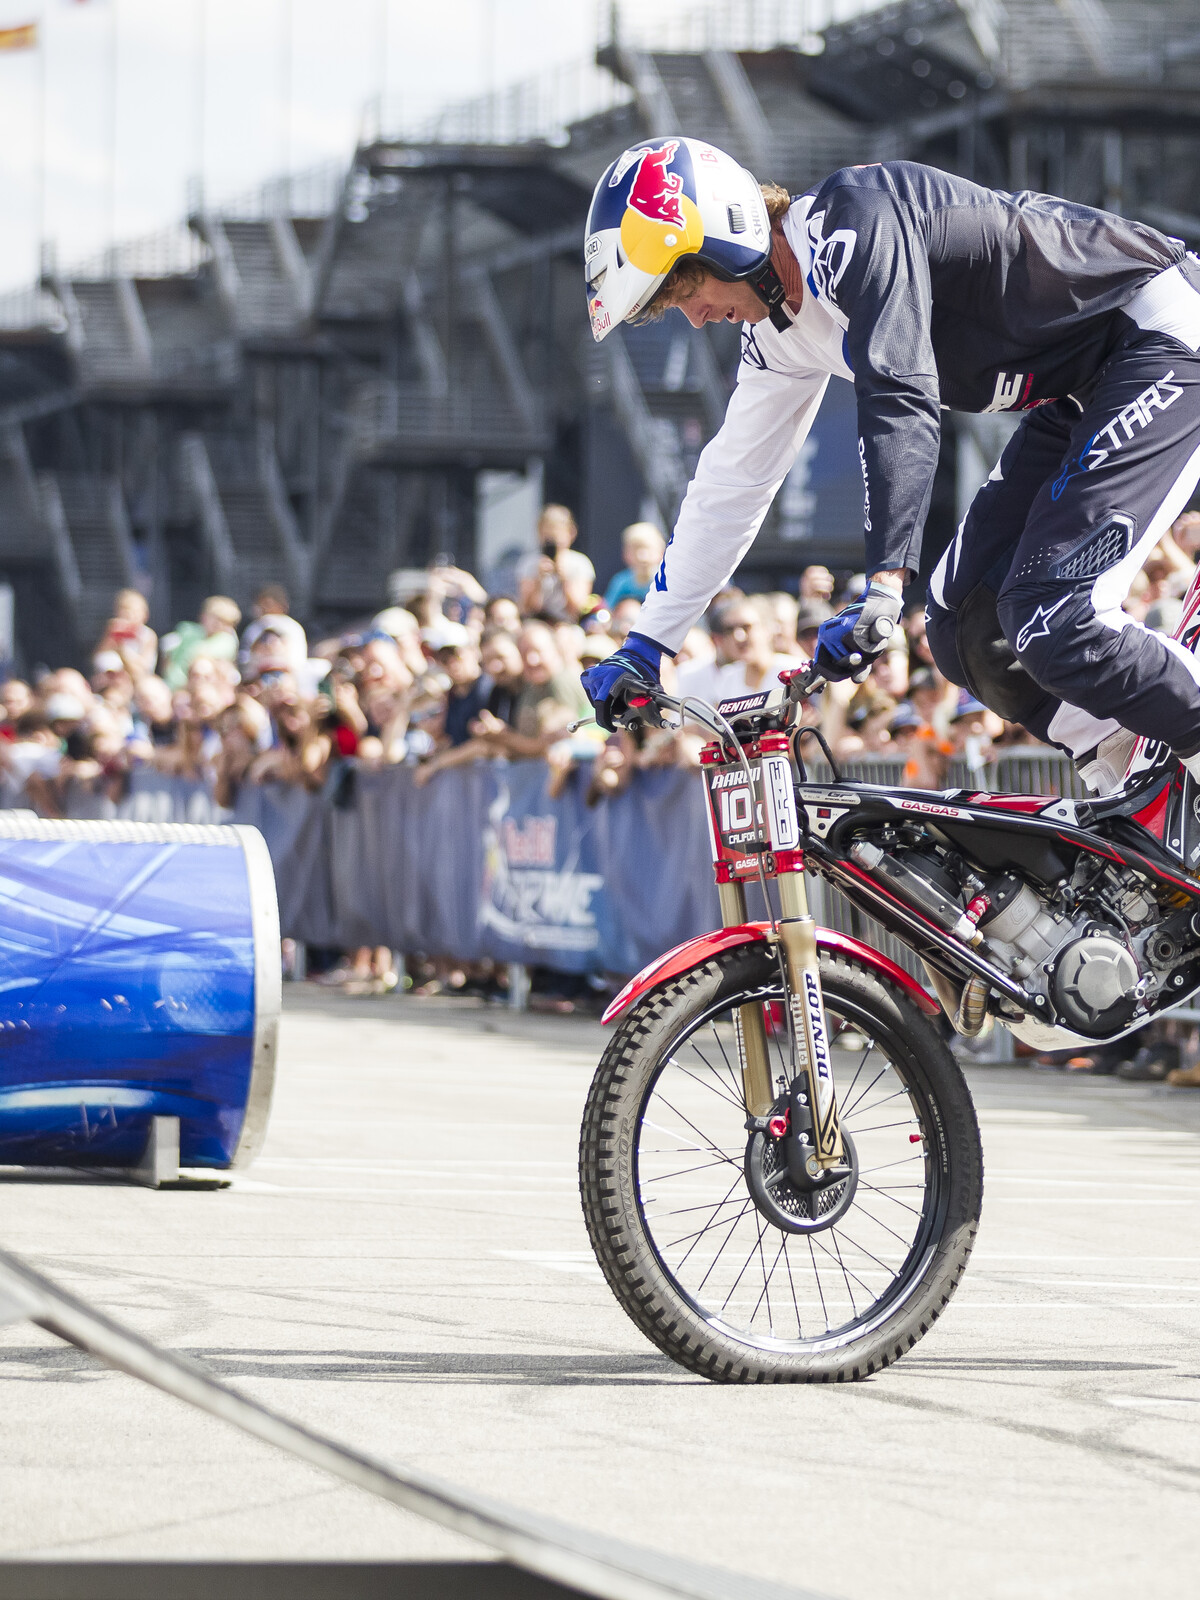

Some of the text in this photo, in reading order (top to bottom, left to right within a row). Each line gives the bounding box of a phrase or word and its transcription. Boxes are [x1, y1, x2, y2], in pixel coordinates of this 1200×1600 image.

[719, 695, 766, 713] RENTHAL
[901, 800, 960, 817] GASGAS
[805, 973, 830, 1081] DUNLOP
[618, 1115, 636, 1231] DUNLOP
